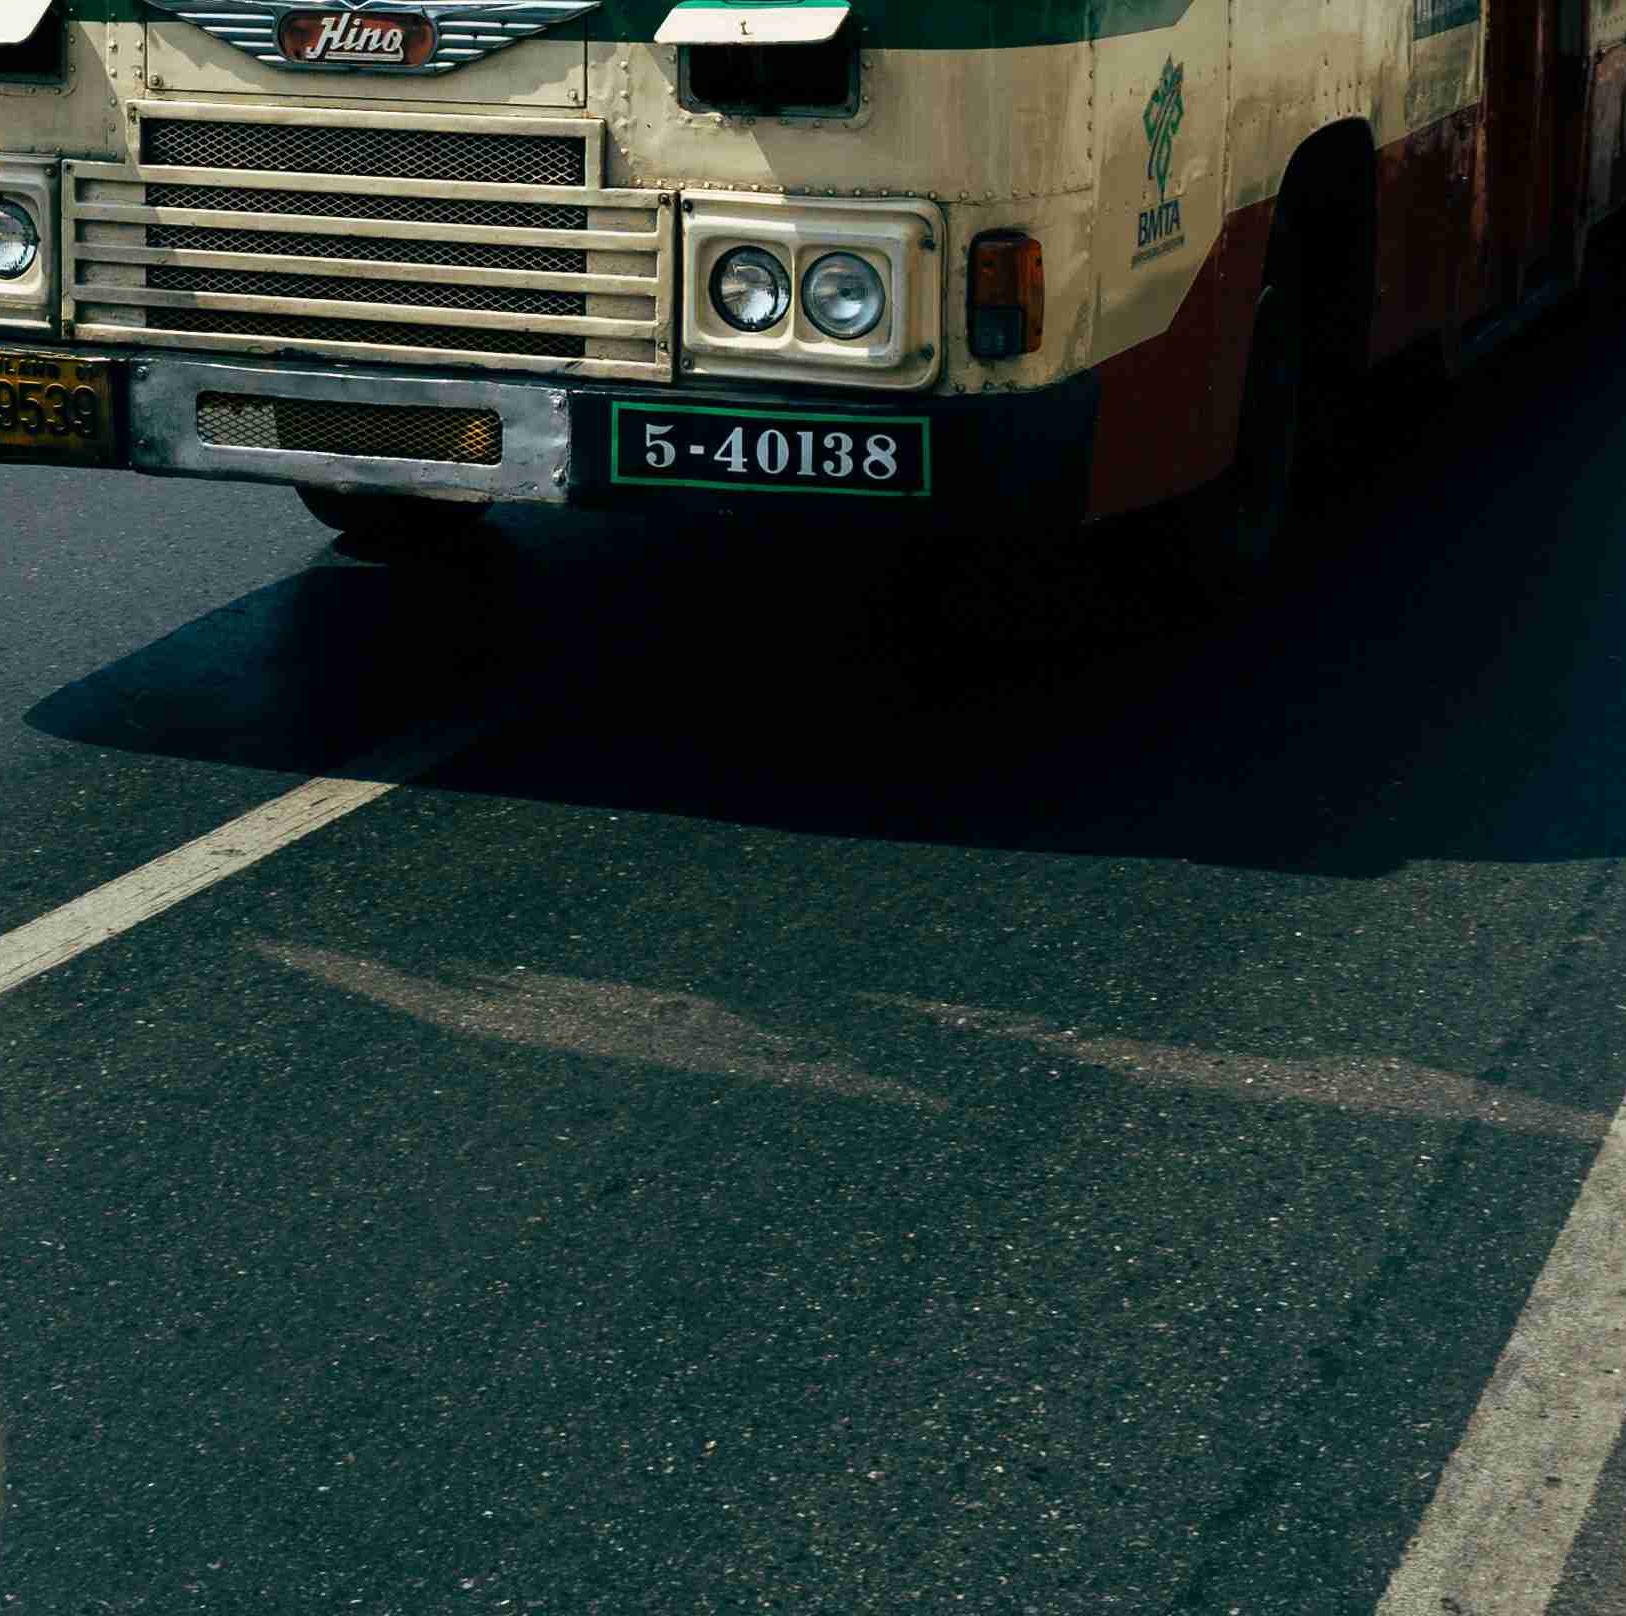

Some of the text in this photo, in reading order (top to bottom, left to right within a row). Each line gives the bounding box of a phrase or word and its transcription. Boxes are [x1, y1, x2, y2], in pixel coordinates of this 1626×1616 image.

[307, 13, 405, 61] Hino
[1138, 199, 1180, 247] BMTA
[645, 422, 897, 480] 5-40138
